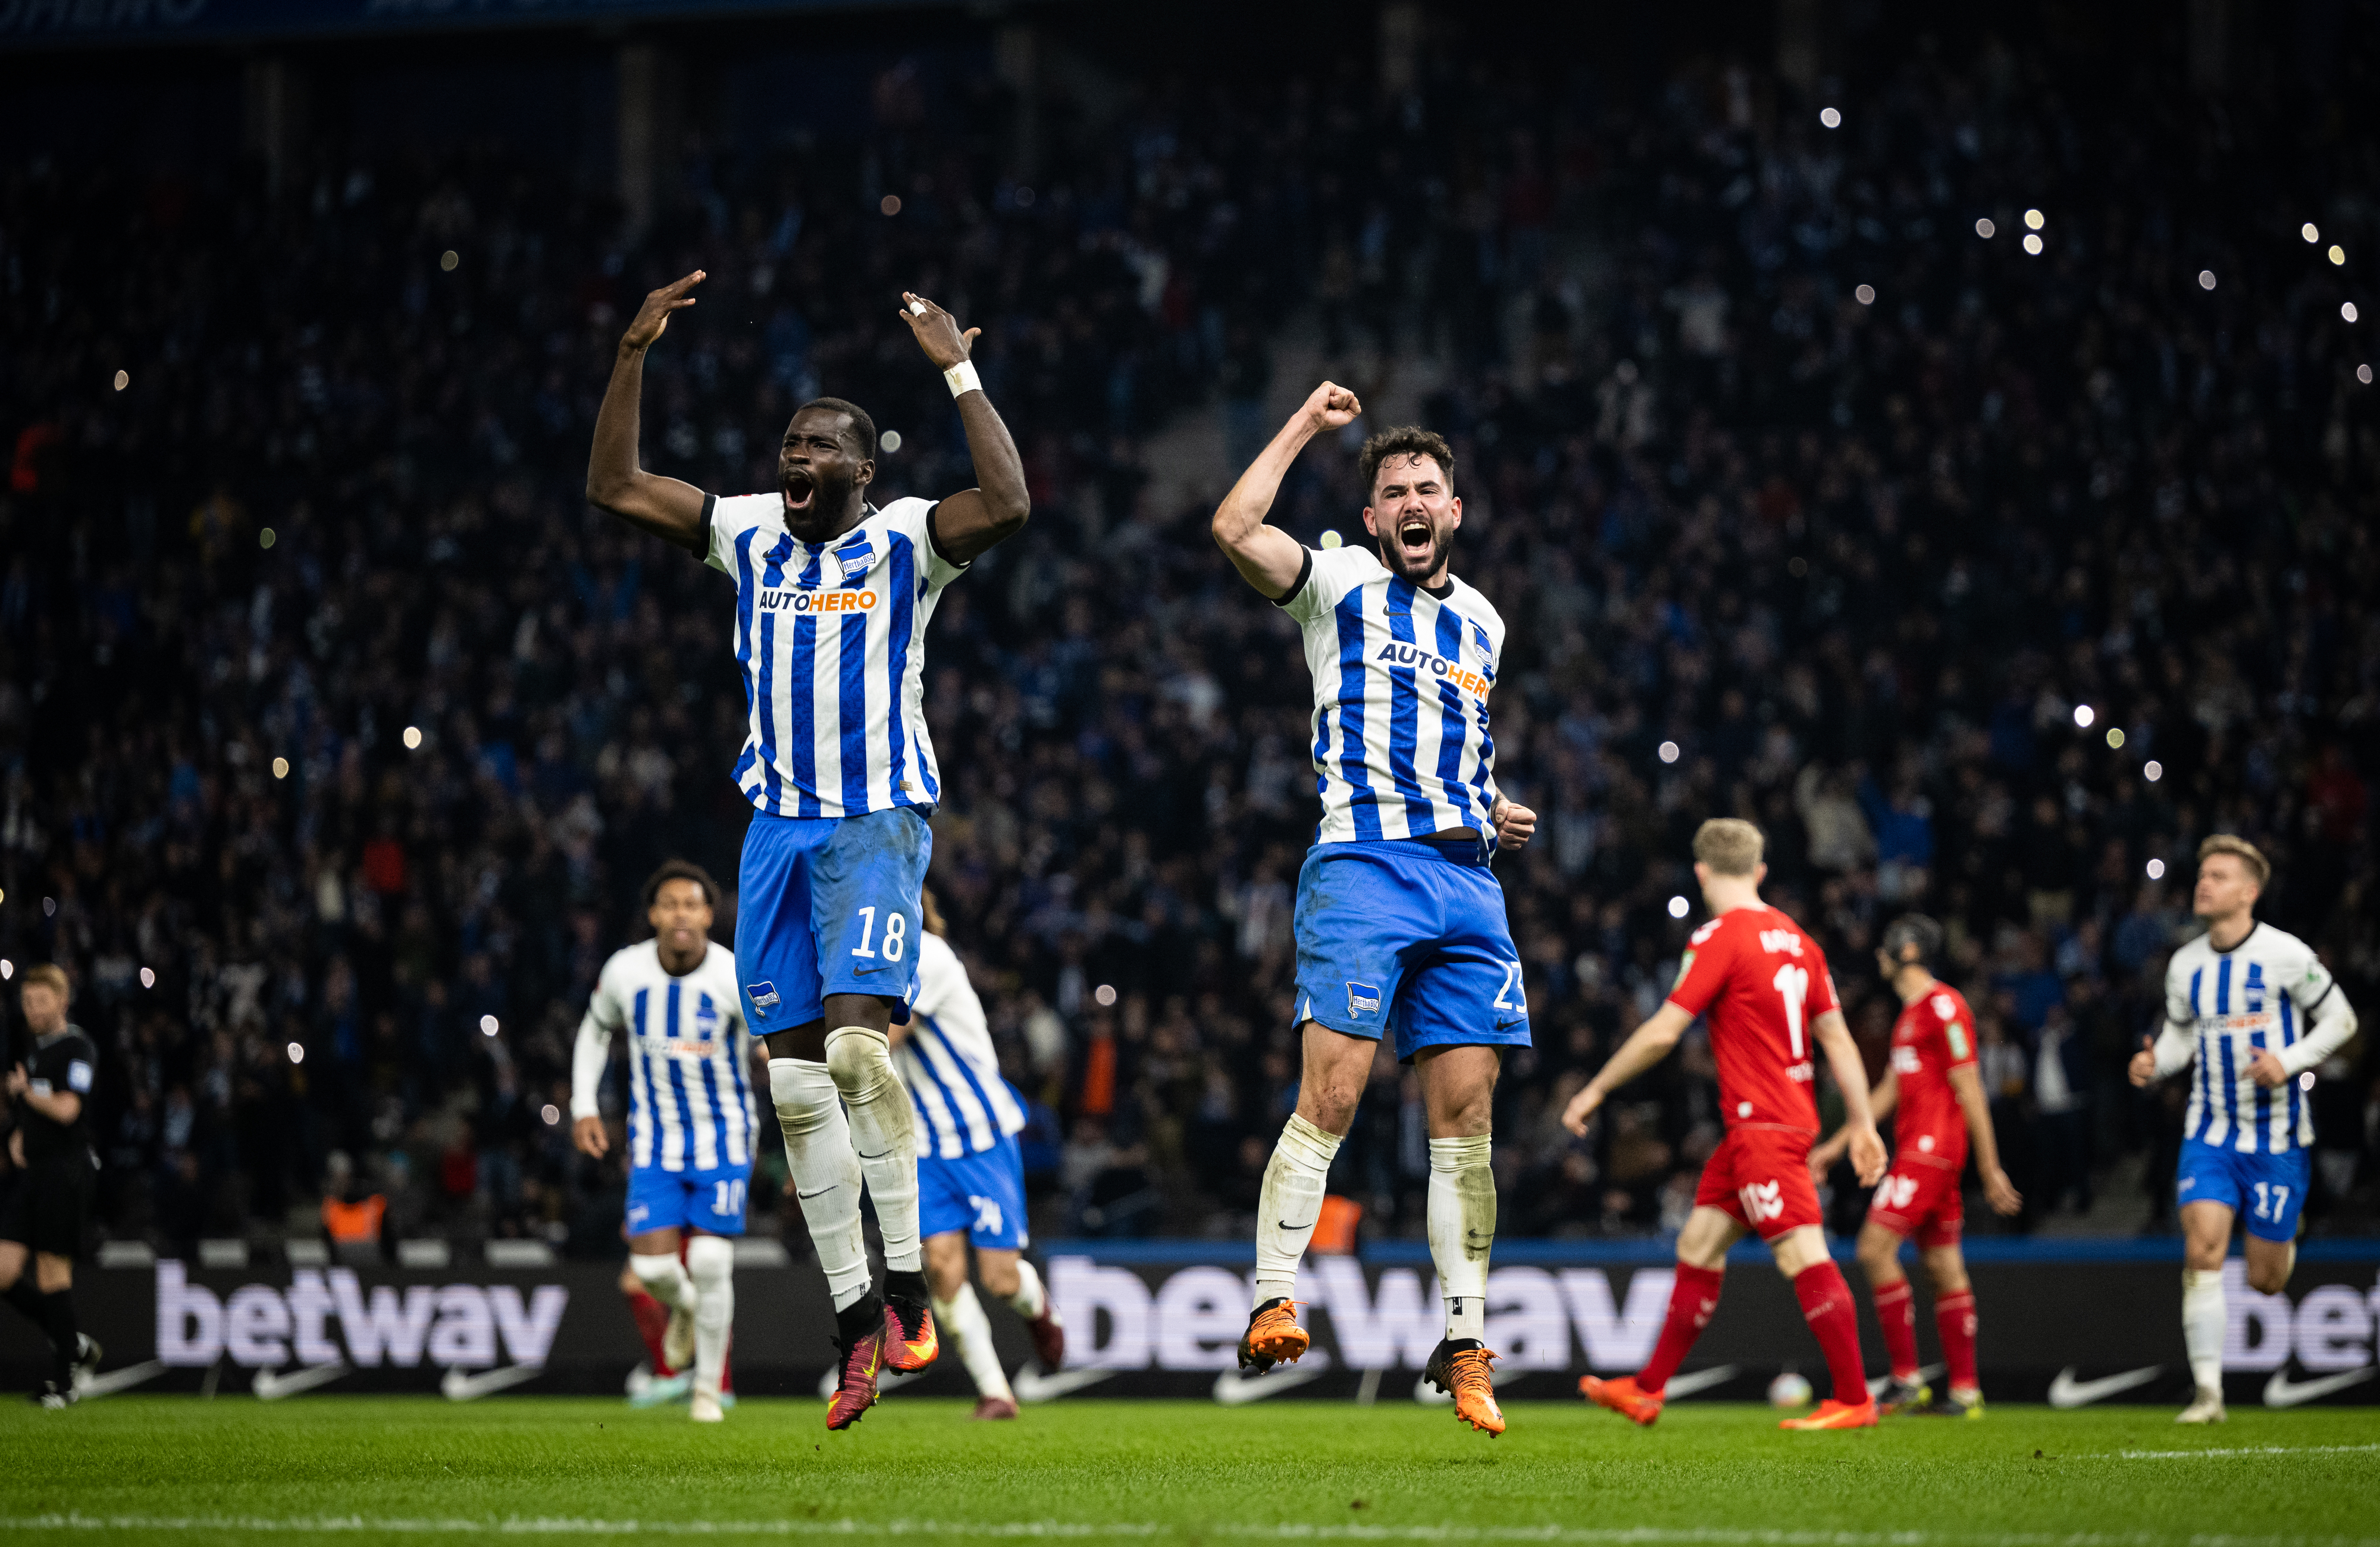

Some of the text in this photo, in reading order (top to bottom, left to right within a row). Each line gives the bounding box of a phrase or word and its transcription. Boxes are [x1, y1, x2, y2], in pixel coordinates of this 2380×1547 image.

[759, 591, 876, 612] AUTOHERO
[851, 906, 906, 962] 18
[1493, 958, 1527, 1014] 23
[2253, 1181, 2290, 1224] 17
